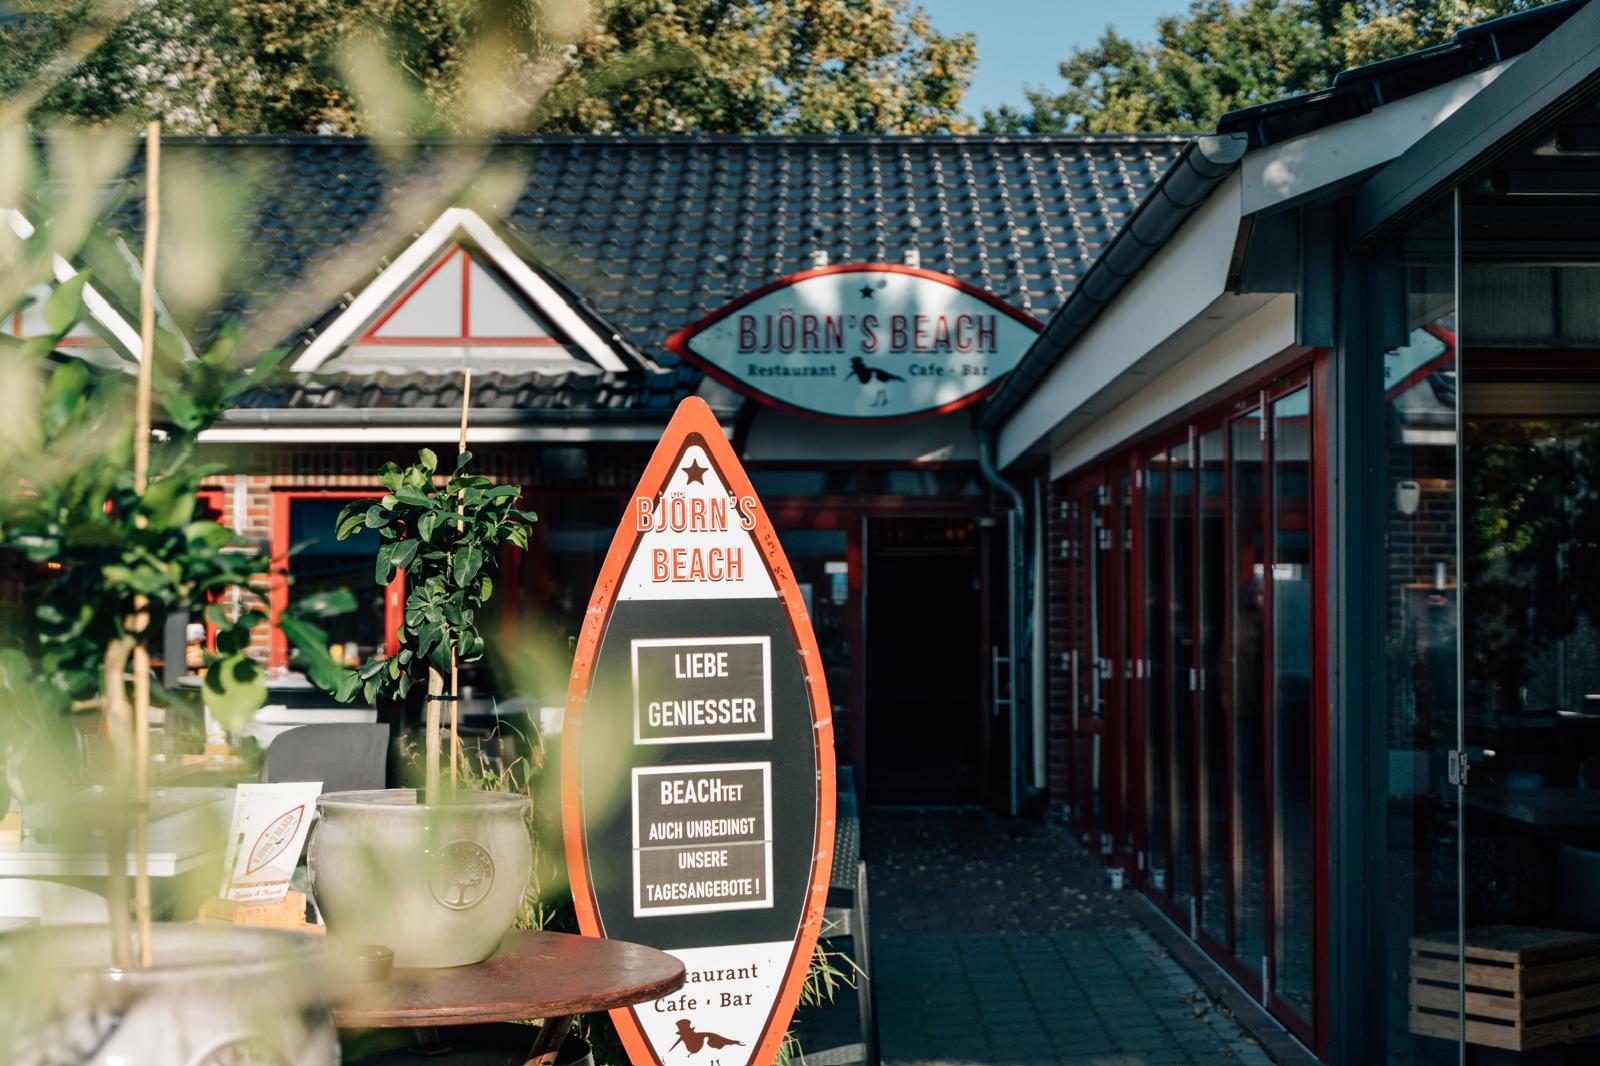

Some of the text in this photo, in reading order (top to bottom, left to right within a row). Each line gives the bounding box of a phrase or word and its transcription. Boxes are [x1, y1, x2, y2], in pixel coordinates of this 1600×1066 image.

[738, 308, 998, 354] BJÖRN'S BEACH
[747, 363, 837, 377] Restaurant
[908, 363, 945, 377] Cafe
[961, 363, 989, 376] Bar
[635, 491, 757, 533] BJÖRN'S
[652, 547, 744, 583] BEACH
[674, 652, 729, 679] LIEBE
[648, 697, 757, 727] GENIESSER
[649, 817, 756, 841] AUCH UNBEDINGT
[678, 849, 728, 870] UNSERE
[646, 878, 753, 902] TAGESANGEBOTE
[684, 963, 759, 984] taurant
[654, 993, 698, 1013] Cafe
[719, 992, 753, 1008] Bar
